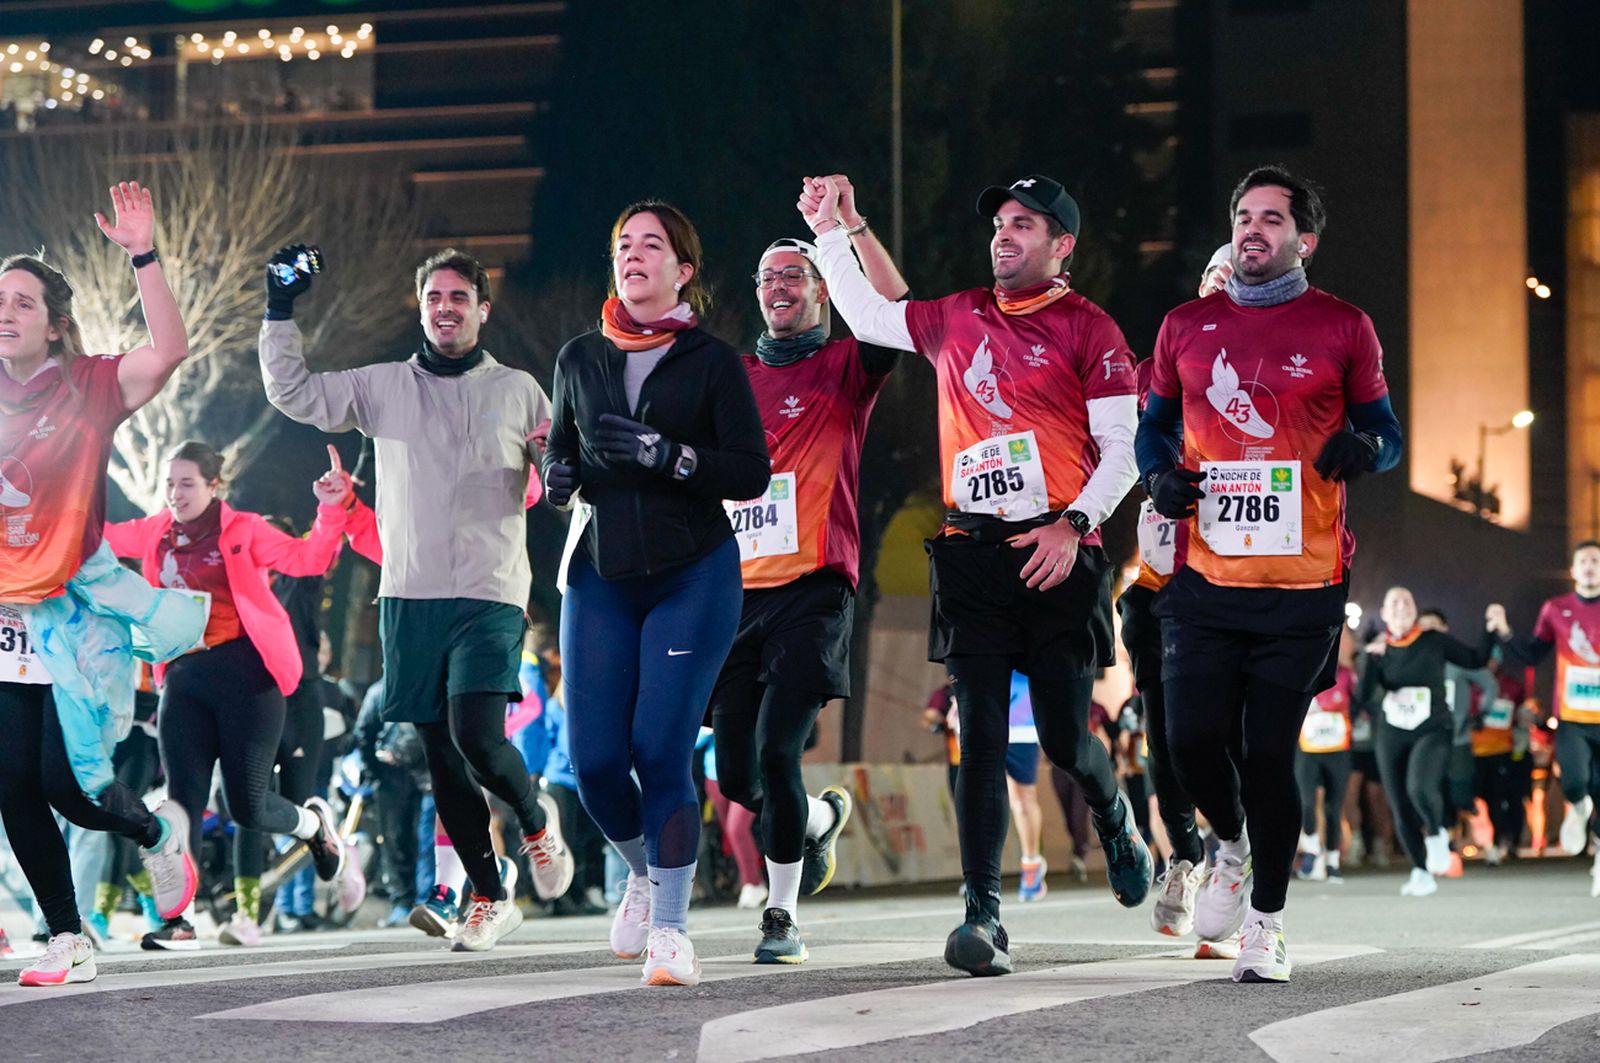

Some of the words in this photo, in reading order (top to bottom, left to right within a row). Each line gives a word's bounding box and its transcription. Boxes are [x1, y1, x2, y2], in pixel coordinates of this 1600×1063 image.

[976, 380, 995, 404] 43
[1225, 397, 1251, 423] 43
[990, 447, 1001, 458] DE
[967, 466, 1024, 502] 2785
[1210, 483, 1227, 493] SAN
[1220, 471, 1248, 481] NOCHE
[1250, 471, 1262, 481] DE
[732, 503, 778, 533] 2784
[1218, 495, 1280, 522] 2786
